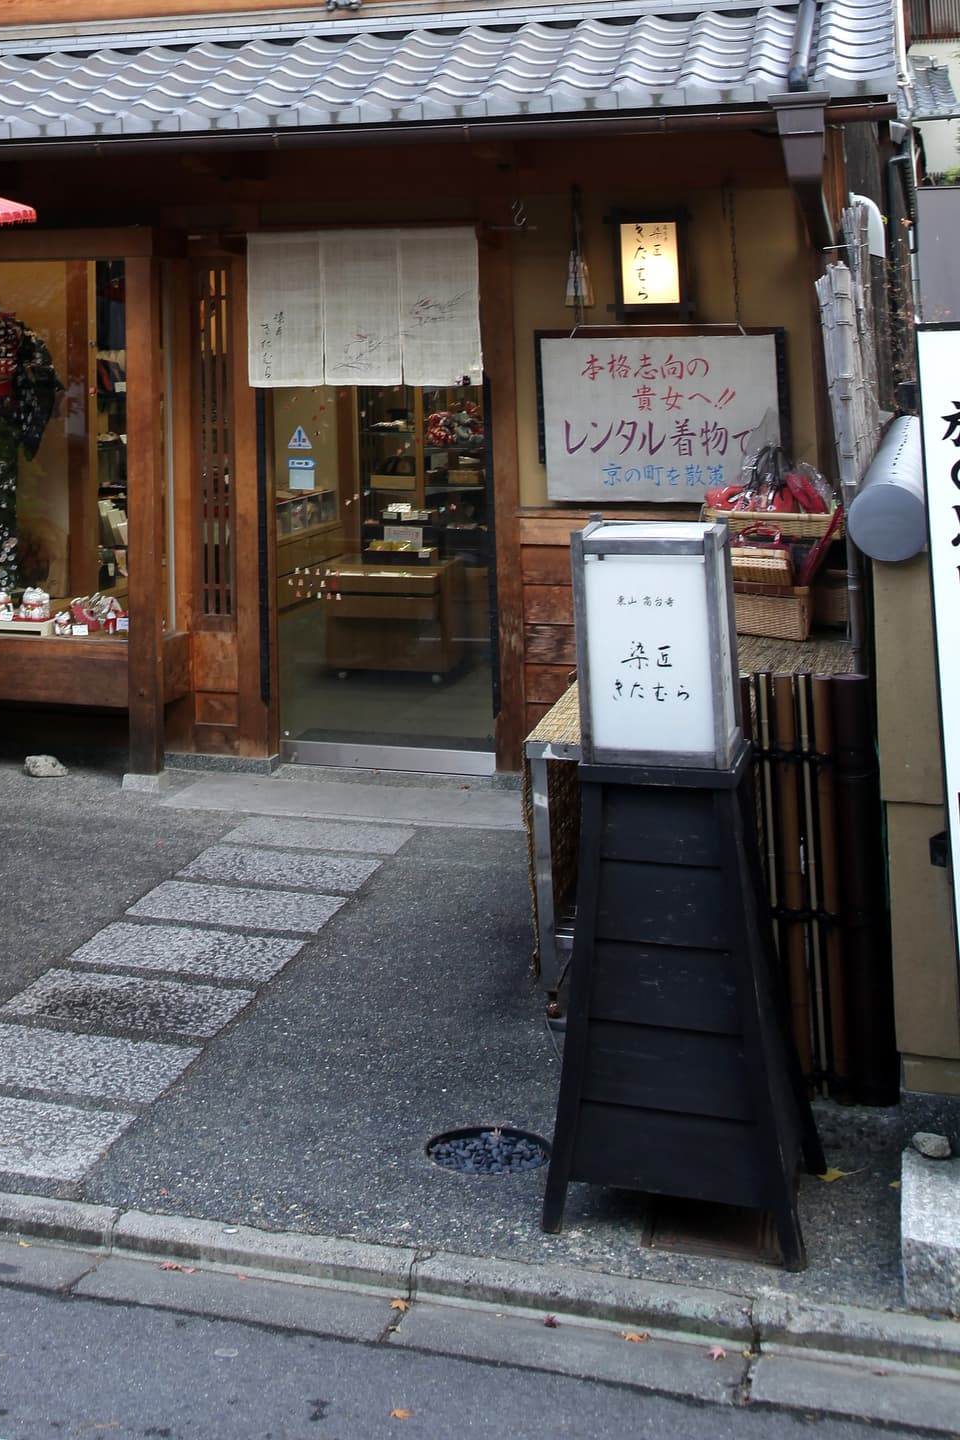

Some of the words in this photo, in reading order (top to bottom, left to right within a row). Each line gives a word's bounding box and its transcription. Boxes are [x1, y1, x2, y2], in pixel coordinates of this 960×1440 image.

[634, 224, 649, 301] きたむら
[581, 354, 710, 380] 本格志向の
[602, 463, 727, 487] 京の町を散策
[612, 679, 690, 702] きたむら
